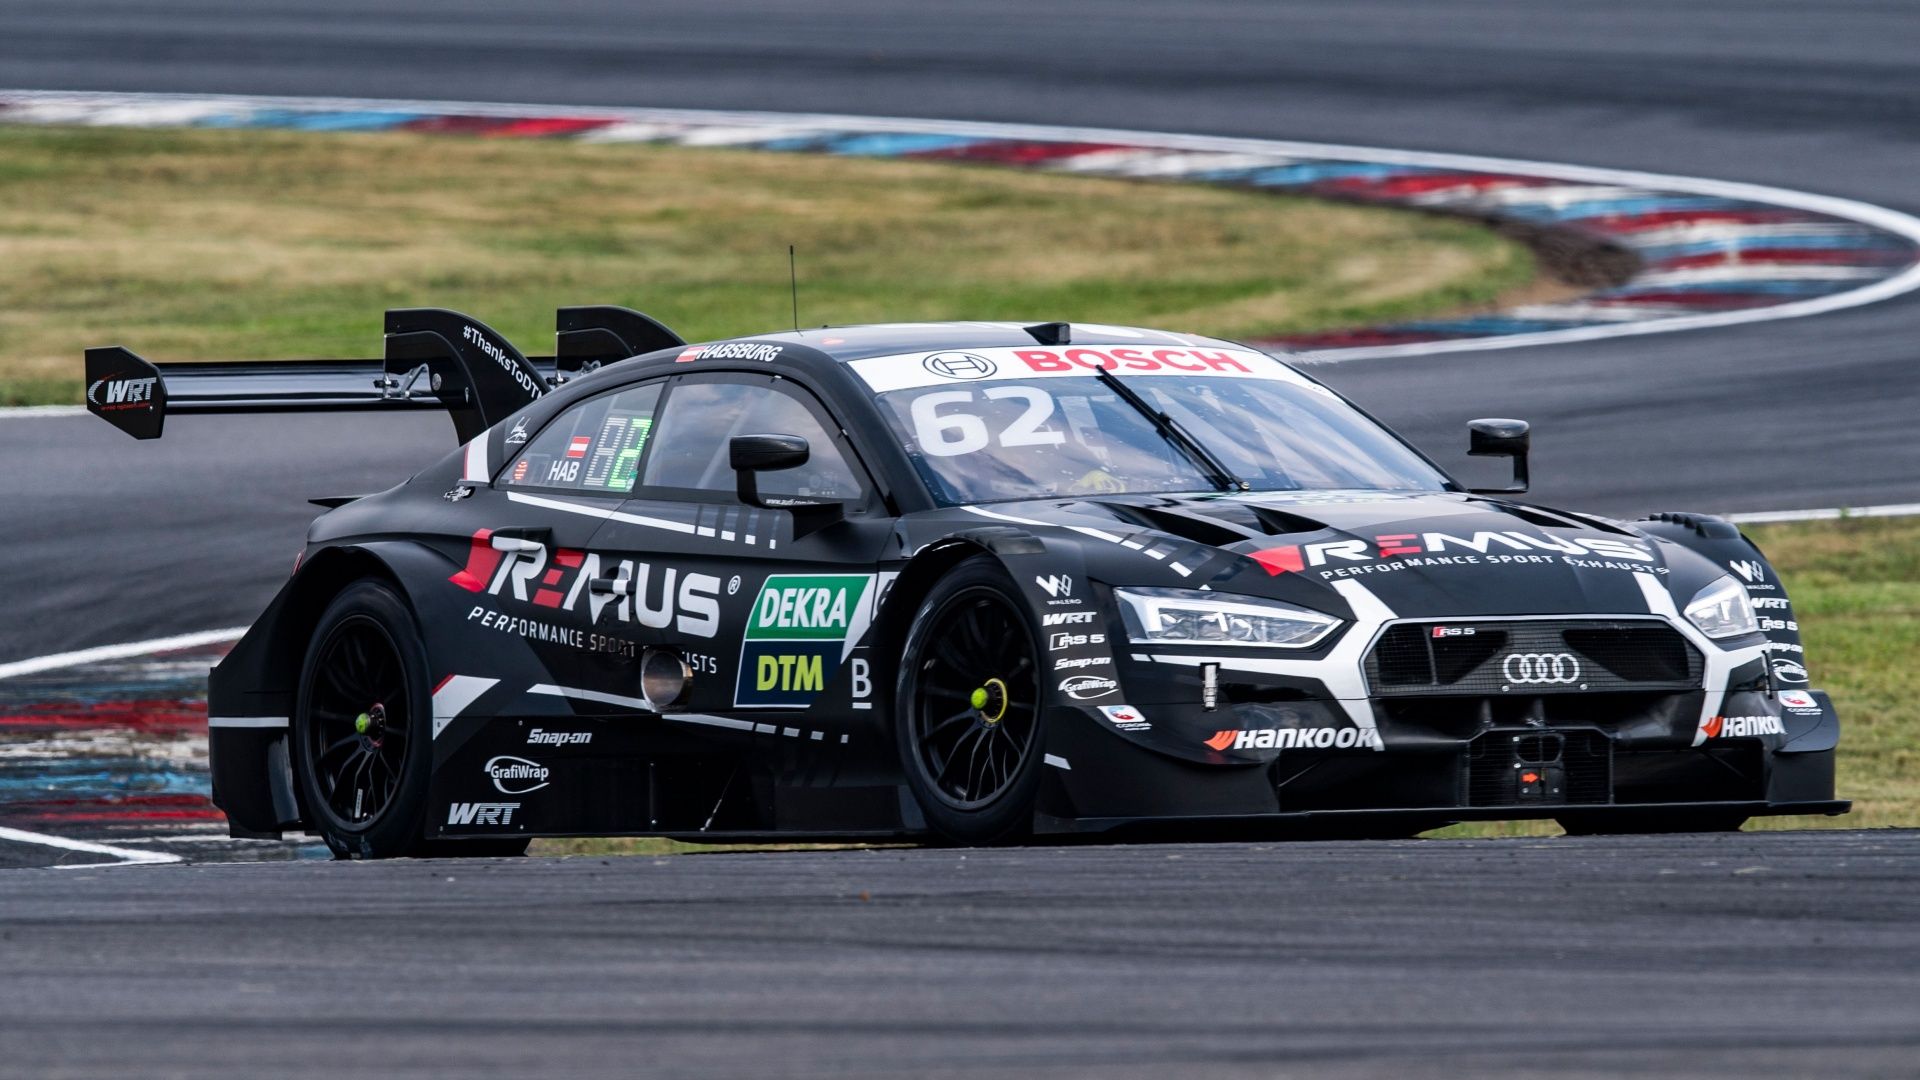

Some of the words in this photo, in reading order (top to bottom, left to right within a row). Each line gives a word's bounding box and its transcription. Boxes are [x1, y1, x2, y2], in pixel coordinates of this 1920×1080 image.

[695, 343, 783, 362] HABSBURG
[1012, 348, 1252, 373] BOSCH
[106, 377, 157, 403] WRT
[910, 386, 1067, 457] 62
[548, 460, 580, 481] HAB
[1305, 531, 1654, 567] REMUS
[1320, 555, 1480, 580] PERFORMANCE
[1490, 554, 1553, 565] SPORT
[1563, 556, 1671, 576] EXHAUSTS
[758, 587, 848, 629] DEKRA
[1043, 611, 1097, 626] WRT
[467, 606, 583, 648] PERFORMANCE
[1090, 634, 1105, 644] 5
[1439, 628, 1462, 636] RS
[1463, 627, 1476, 635] 5
[756, 654, 824, 692] DTM
[1054, 656, 1111, 670] Snap-on
[852, 658, 872, 699] B
[527, 728, 592, 747] Snap-on
[490, 764, 549, 781] GrafiWrap
[447, 802, 521, 825] WRT
